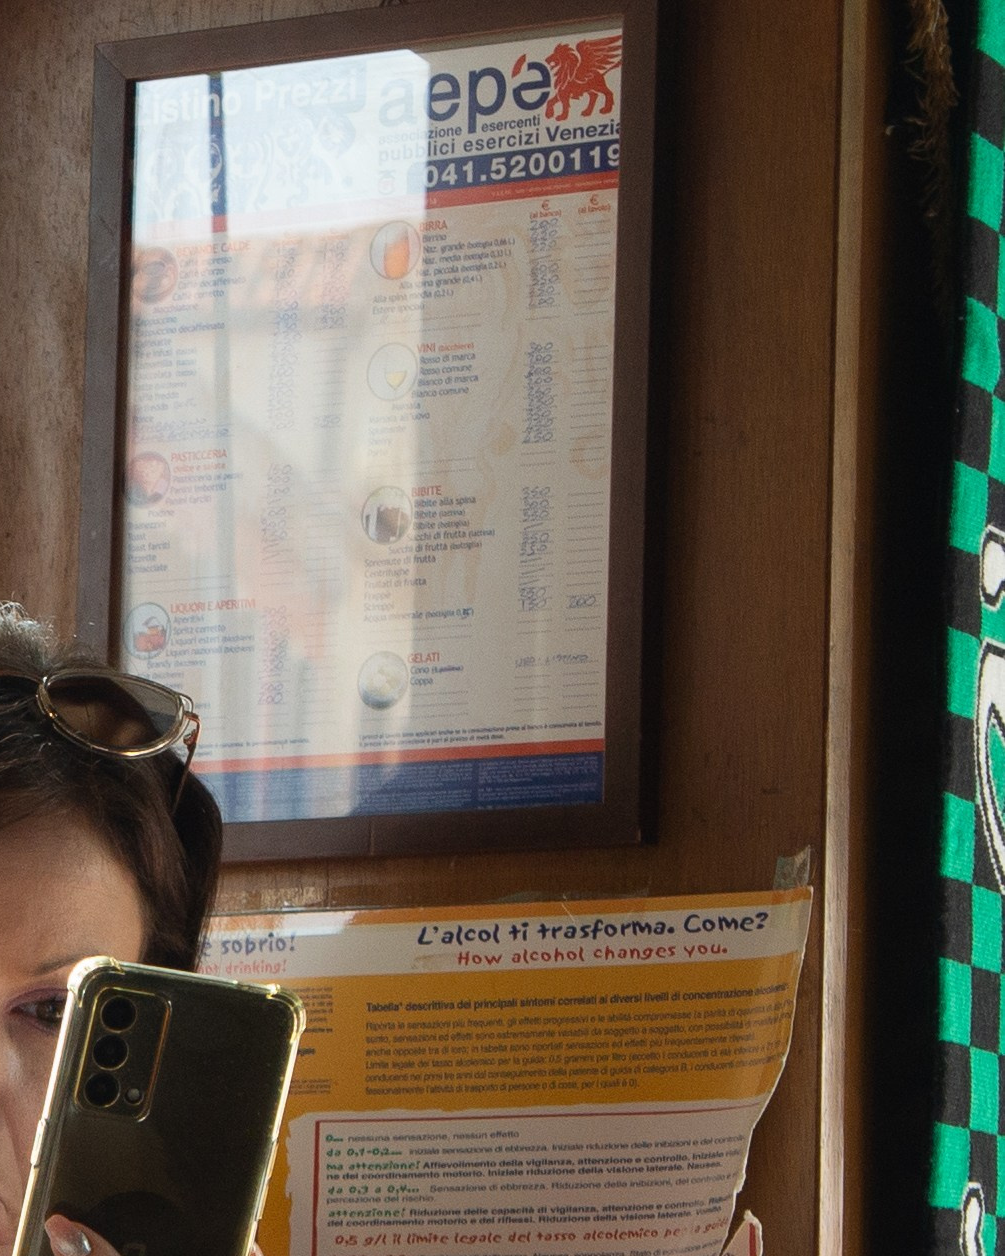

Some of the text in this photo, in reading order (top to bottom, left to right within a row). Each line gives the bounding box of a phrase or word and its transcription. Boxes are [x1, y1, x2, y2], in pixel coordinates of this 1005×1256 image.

[482, 114, 540, 132] esercenti
[379, 139, 455, 165] pubblici
[464, 128, 540, 153] esercizi
[426, 146, 620, 188] 041.5200119
[412, 486, 442, 497] BIBITE
[407, 652, 440, 663] GELATI
[508, 922, 529, 942] ti
[537, 918, 675, 940] trasforma.
[683, 912, 769, 933] Come?
[221, 932, 295, 955] sobrio!
[457, 942, 728, 966] How alcohol changes you.
[225, 959, 287, 975] drinking!
[405, 1000, 454, 1012] descrittiva
[474, 998, 517, 1011] principali
[520, 997, 555, 1006] sintomi
[610, 993, 642, 1004] diversi
[683, 987, 753, 1001] concentrazione
[327, 1148, 343, 1156] da
[327, 1162, 343, 1170] ma
[349, 1160, 420, 1170] attenzione!
[423, 1161, 496, 1170] Affievolimento
[499, 1159, 524, 1167] della
[578, 1156, 633, 1165] attenzione
[362, 1171, 440, 1180] coordinamento
[526, 1166, 575, 1175] riduzione
[578, 1165, 604, 1174] della
[606, 1164, 643, 1174] visione
[329, 1207, 405, 1217] attenzione!
[410, 1208, 460, 1216] Riduzione
[602, 1203, 654, 1213] attenzione
[347, 1212, 655, 1227] coordinamento motorio Riduzione della visione
[407, 1233, 449, 1245] limite
[455, 1232, 501, 1246] legale
[509, 1231, 530, 1243] del
[537, 1230, 577, 1242] tasso
[583, 1227, 659, 1240] alcolemico
